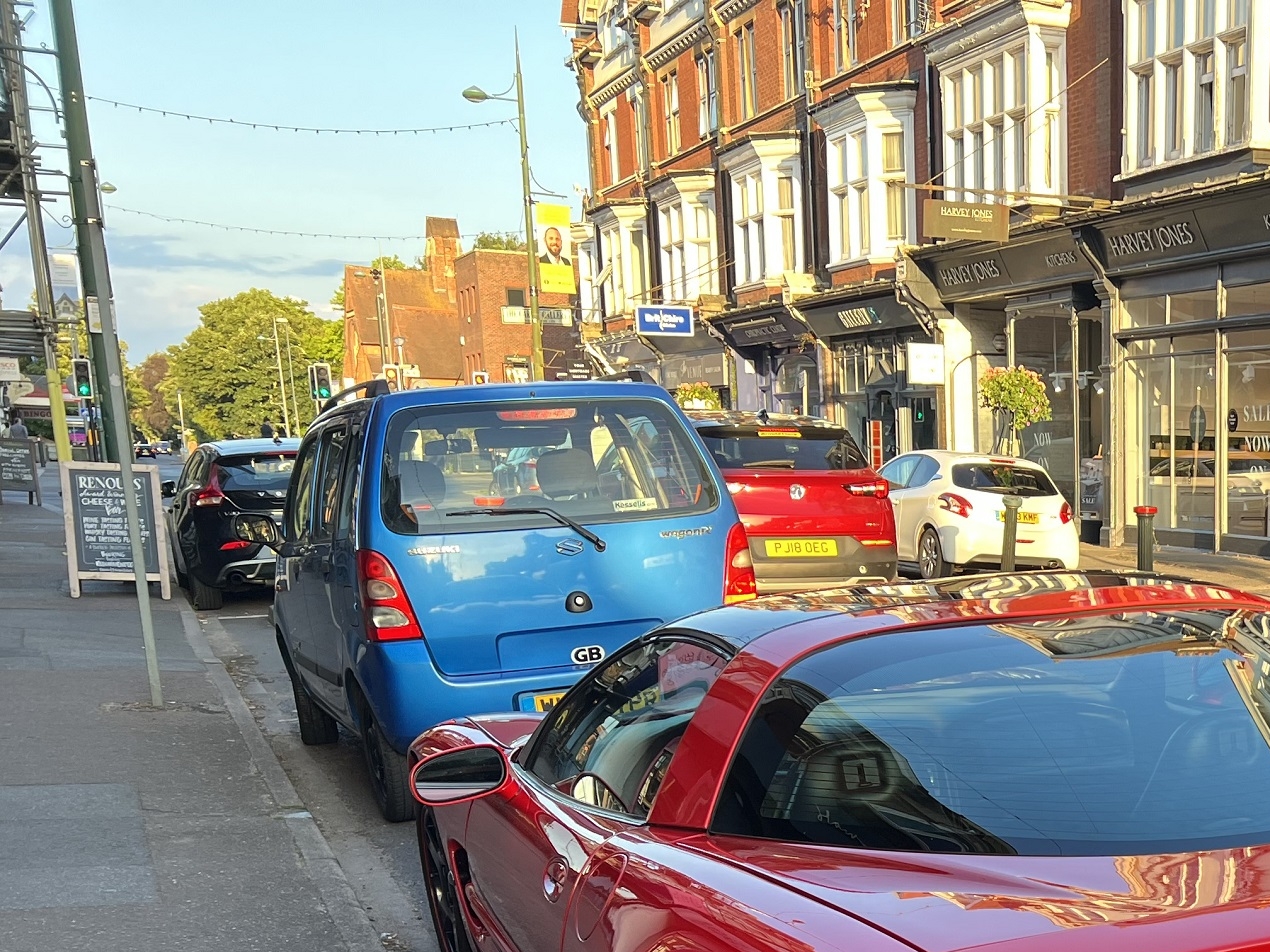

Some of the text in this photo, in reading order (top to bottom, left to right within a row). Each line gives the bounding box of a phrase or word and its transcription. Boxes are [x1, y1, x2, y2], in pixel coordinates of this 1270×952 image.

[941, 206, 993, 218] HARVEY JONES
[1108, 229, 1154, 257] HARVEY
[1154, 222, 1194, 252] JONES
[939, 251, 1077, 286] HARVEY JONES KITCHENS
[1033, 432, 1053, 447] NOW
[81, 497, 113, 506] CHEESE
[774, 542, 829, 553] PJ18 OEG
[574, 647, 602, 662] GB
